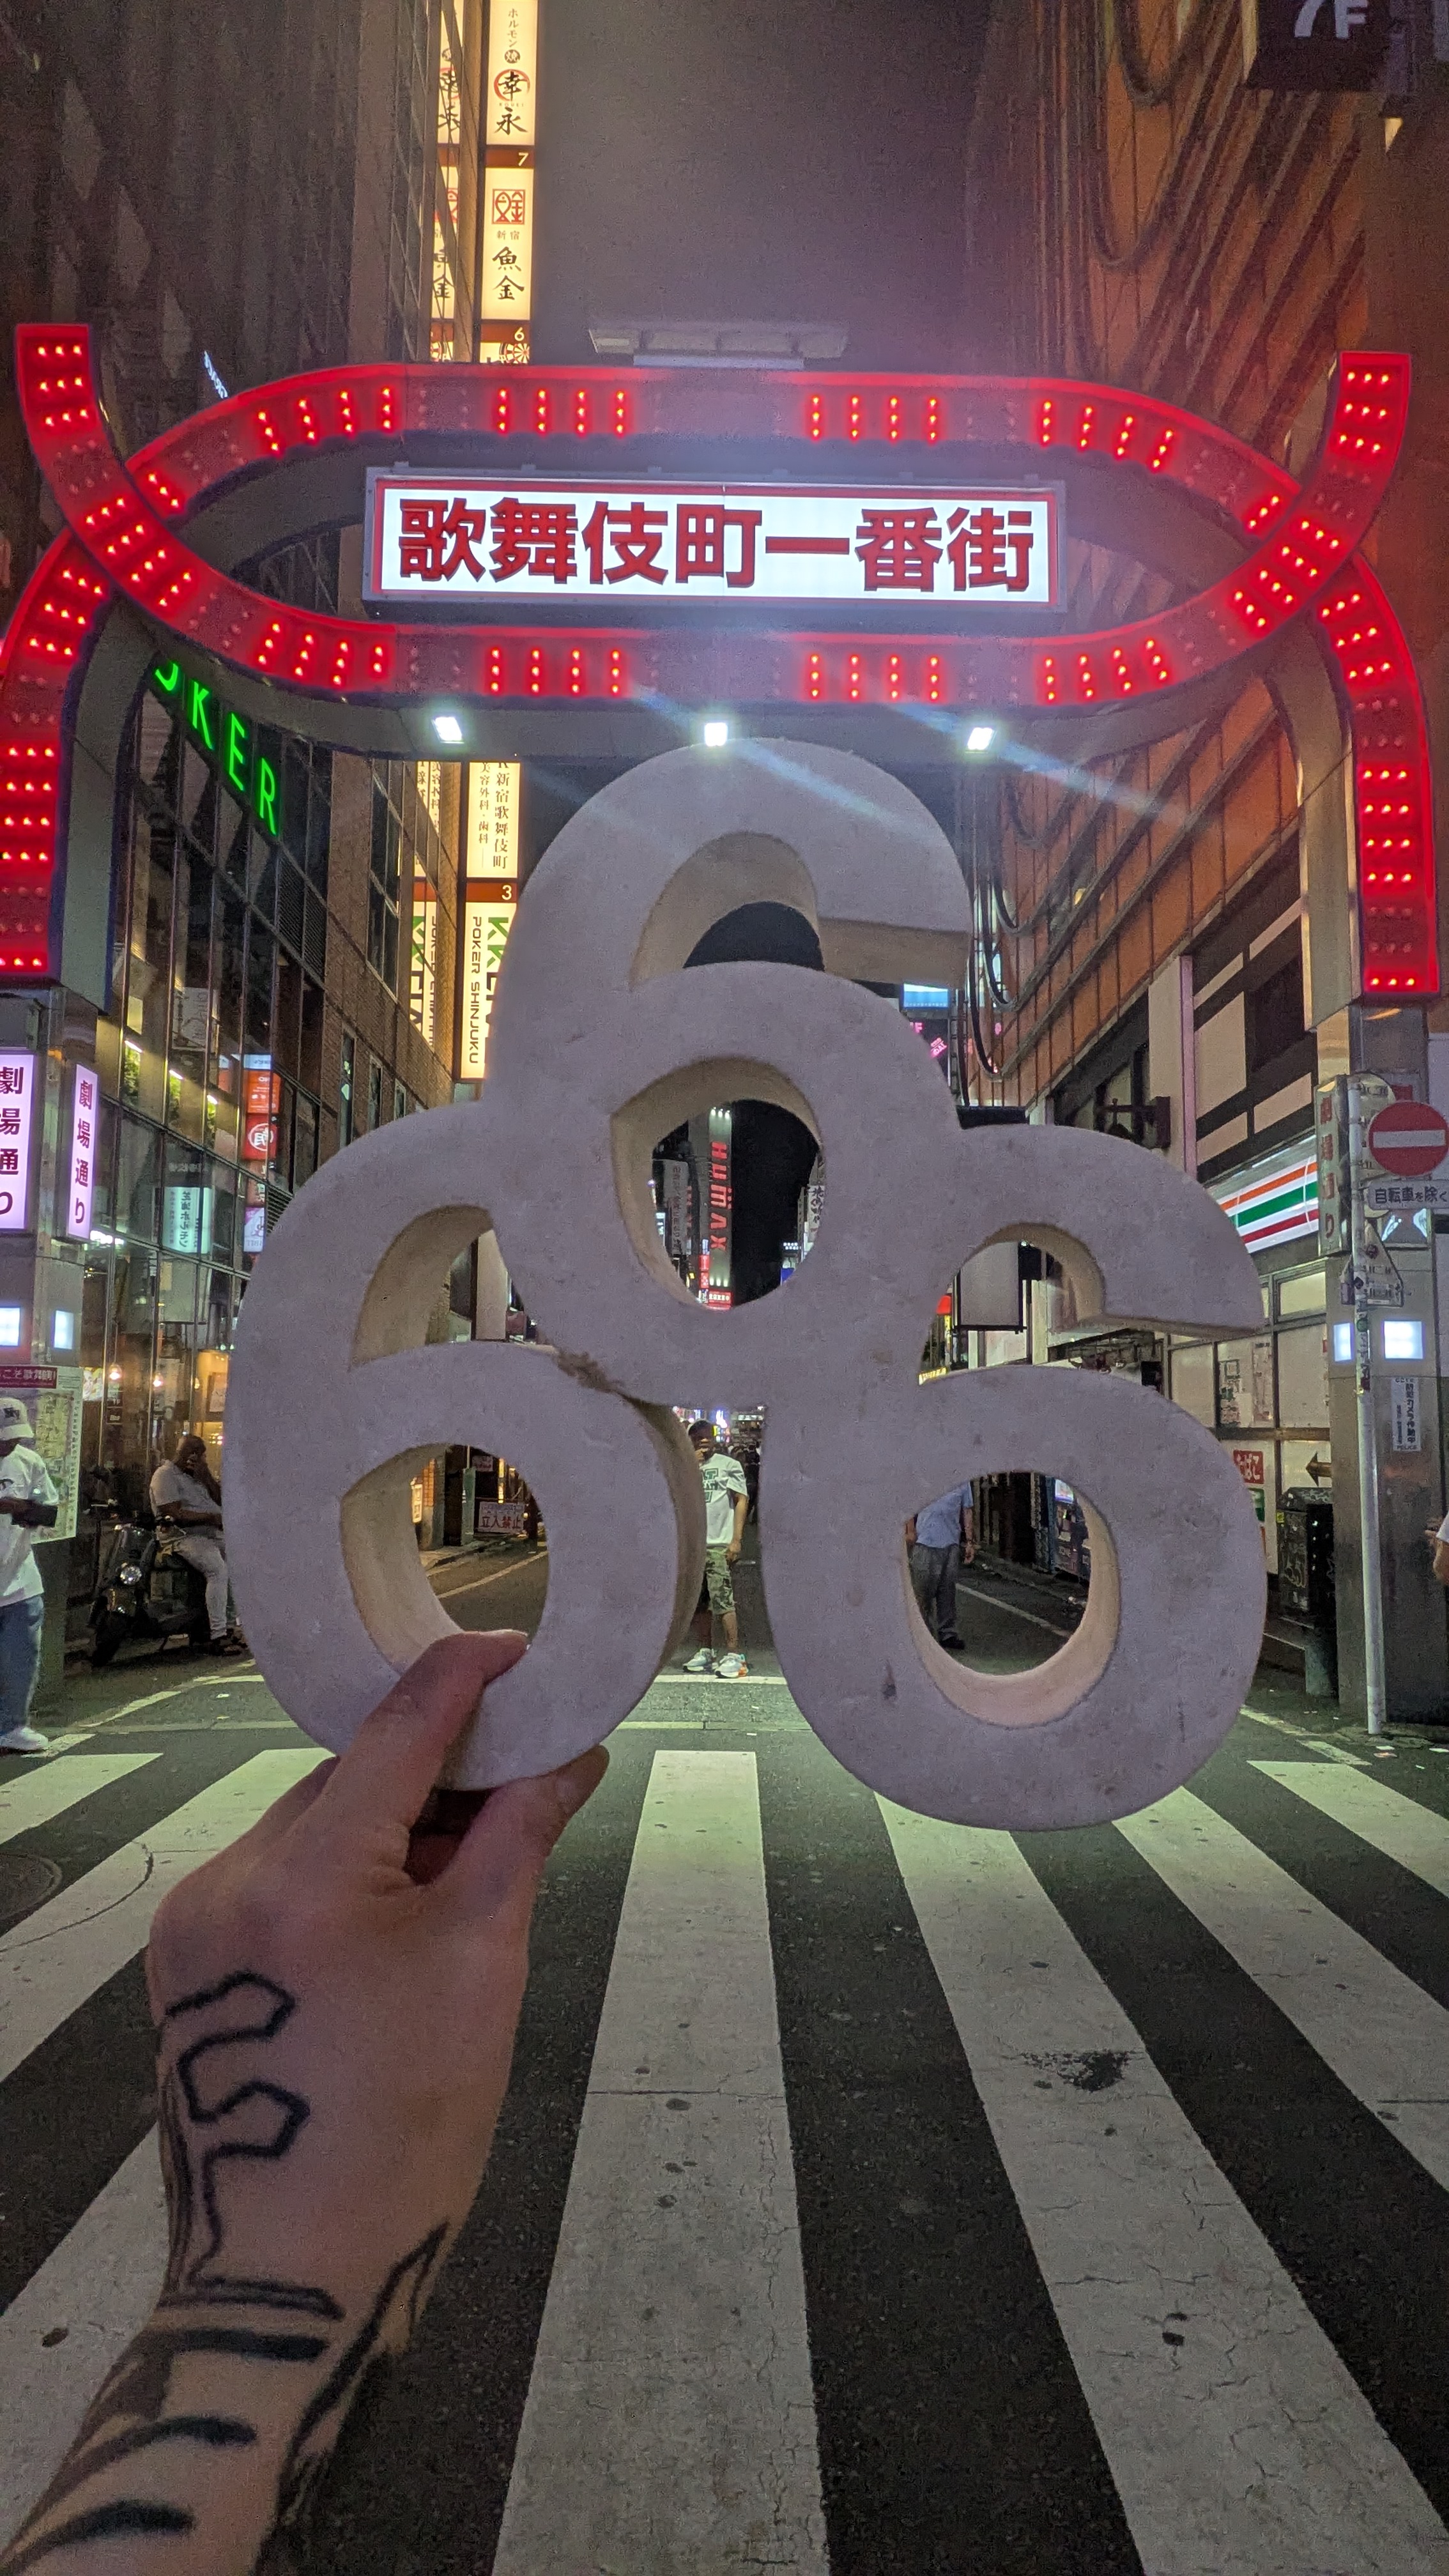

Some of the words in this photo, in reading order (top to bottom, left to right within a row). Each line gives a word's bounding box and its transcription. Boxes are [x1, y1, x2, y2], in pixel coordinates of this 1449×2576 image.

[518, 152, 529, 166] 7
[496, 230, 521, 241] 新宿
[492, 246, 525, 300] 魚金
[514, 326, 525, 342] 6
[399, 497, 1034, 592] 歌舞伎町一番街
[502, 884, 512, 901] 3
[471, 916, 482, 974] POKER
[470, 981, 480, 1064] SHINJUKU
[74, 1080, 93, 1224] 劇場通り
[1374, 1186, 1448, 1204] 自転車を除く
[480, 1515, 521, 1529] 立入禁止
